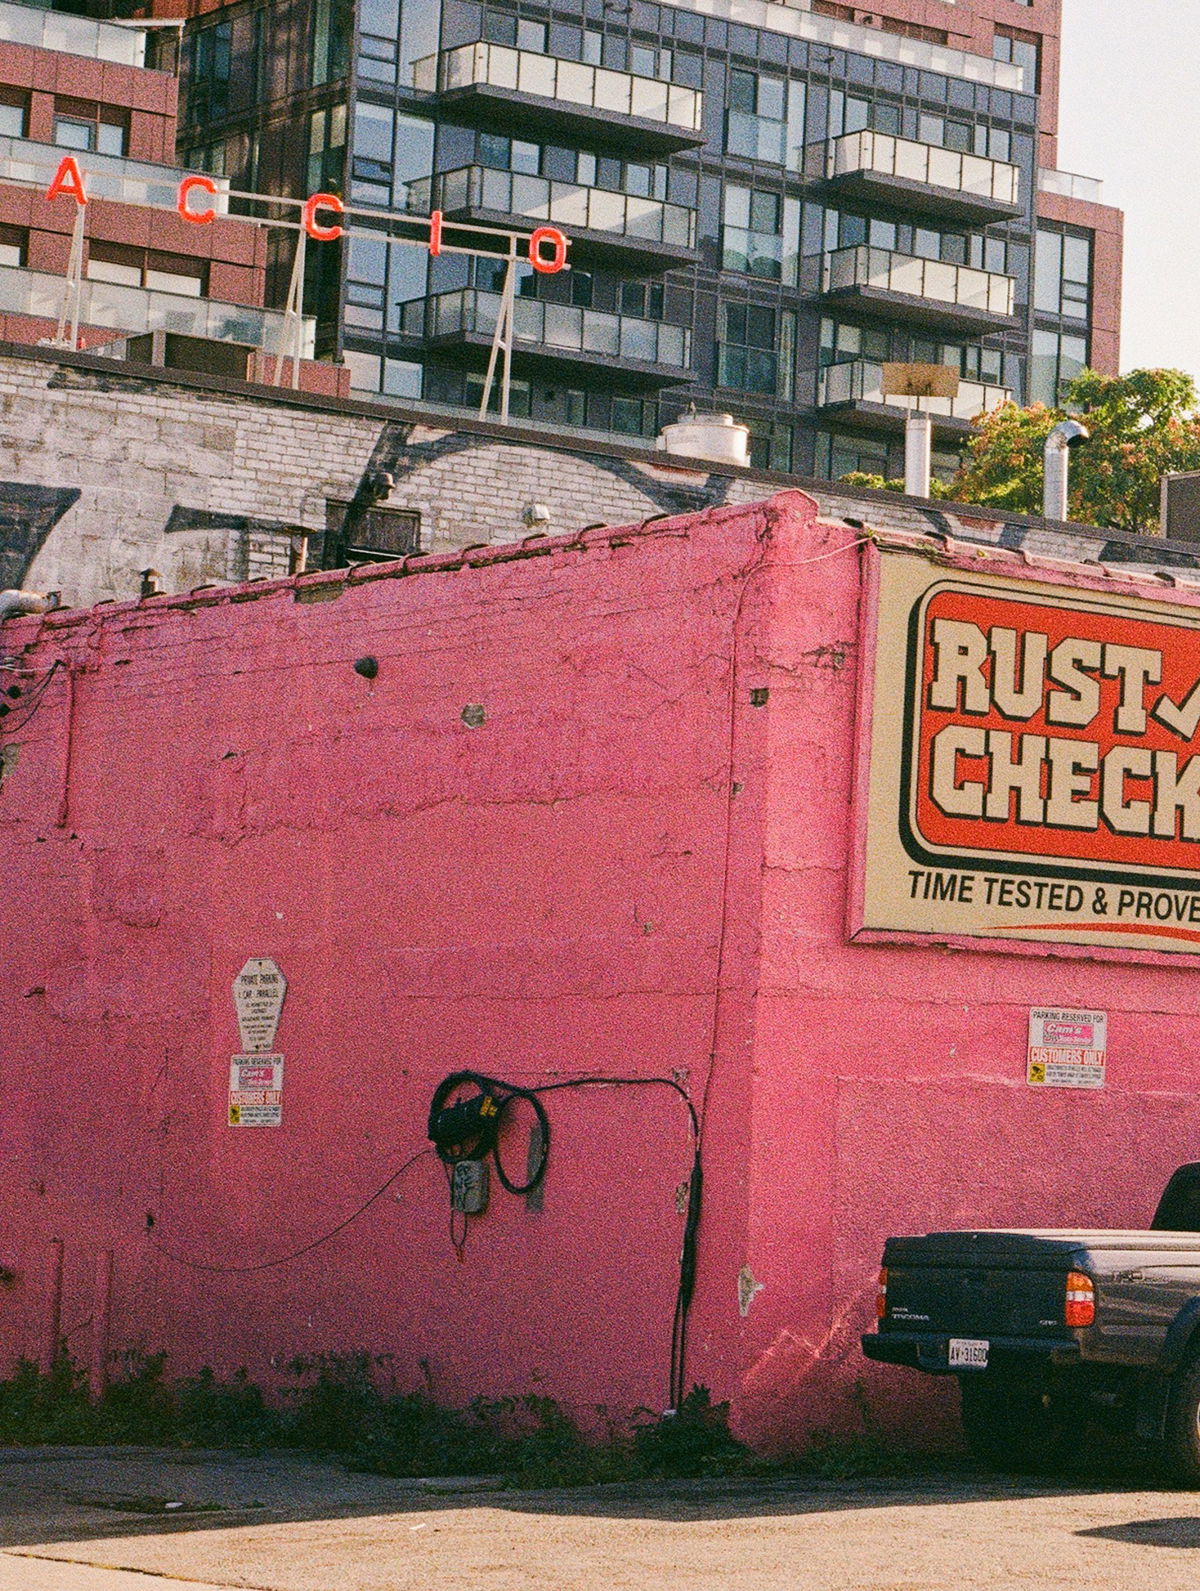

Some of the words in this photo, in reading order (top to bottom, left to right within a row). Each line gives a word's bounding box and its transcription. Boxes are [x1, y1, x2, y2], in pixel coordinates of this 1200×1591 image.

[45, 156, 568, 274] ACCIO
[927, 616, 1163, 735] RUST
[907, 870, 975, 903] TIME
[983, 876, 1084, 913] TESTED
[1091, 887, 1109, 916] &
[1033, 1011, 1060, 1020] PARKING
[1061, 1012, 1092, 1022] RESERVED
[1093, 1015, 1104, 1023] FOR
[1031, 1047, 1082, 1064] CUSTOMERS
[1084, 1050, 1104, 1065] ONLY
